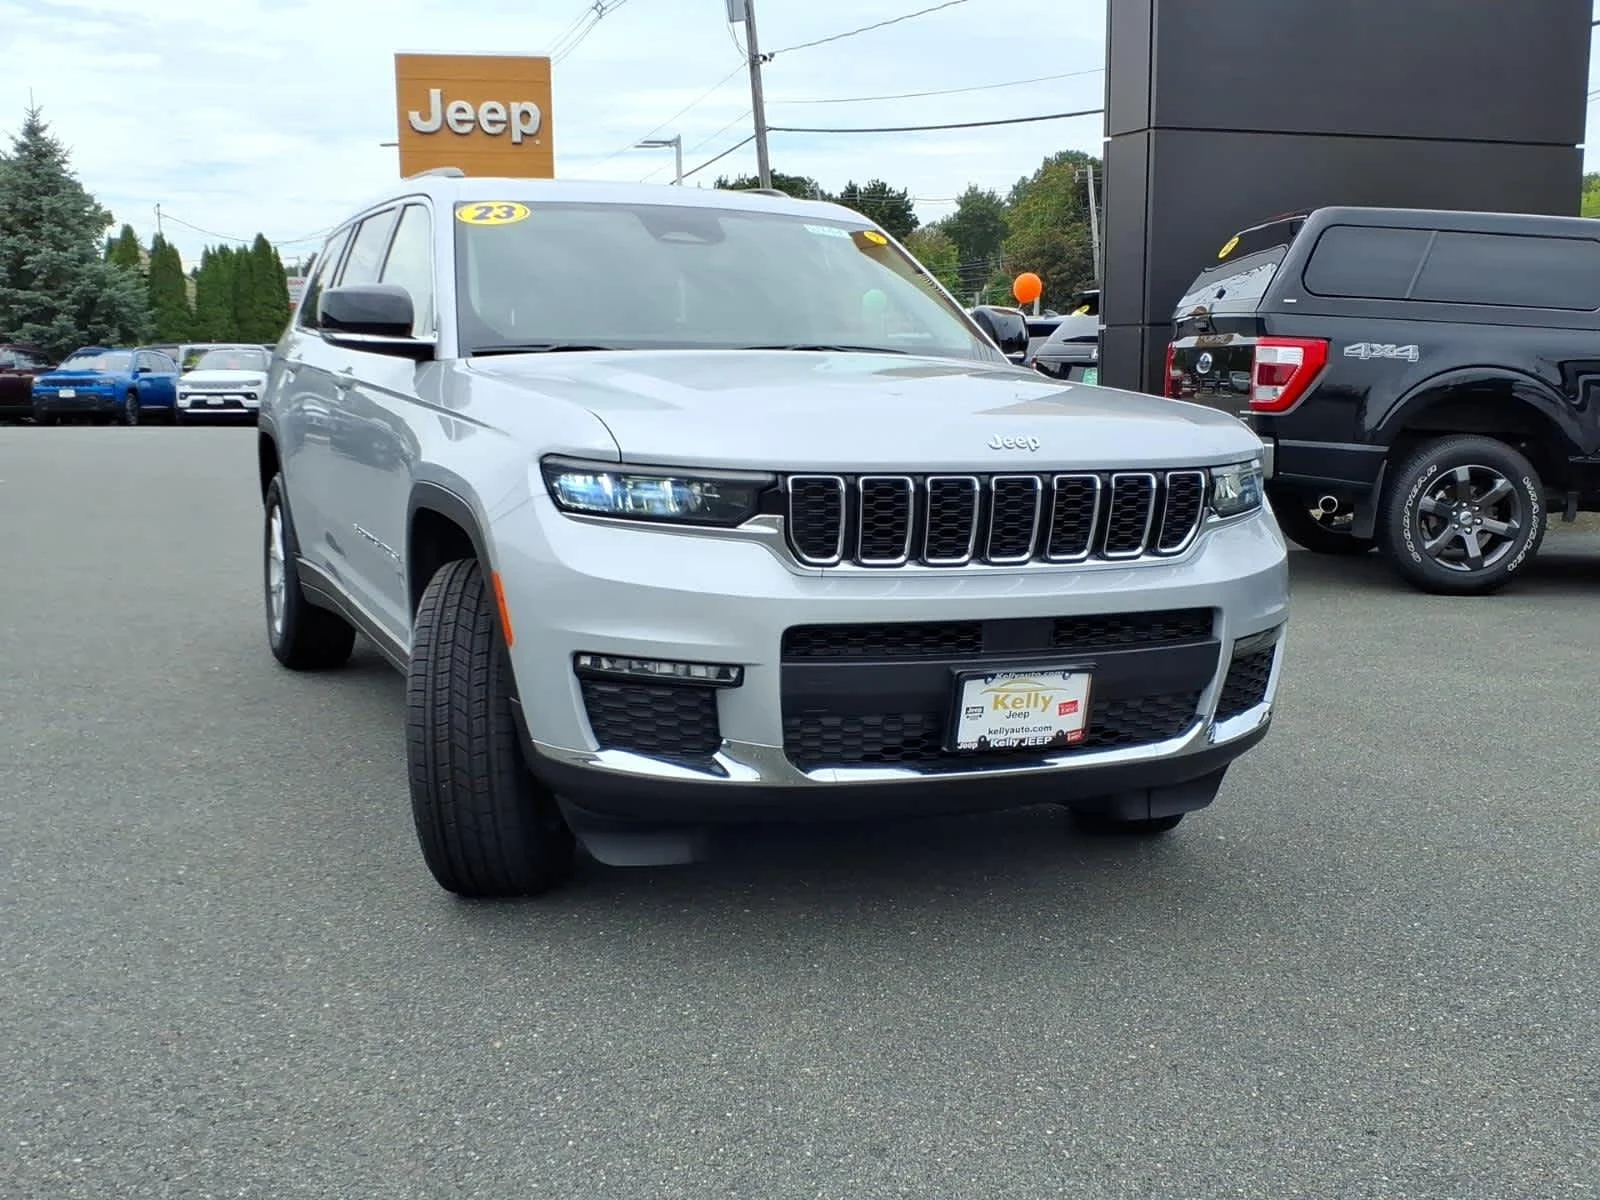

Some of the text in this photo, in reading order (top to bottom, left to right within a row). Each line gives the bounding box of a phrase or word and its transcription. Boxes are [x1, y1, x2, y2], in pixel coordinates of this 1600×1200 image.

[408, 88, 541, 144] Jeep
[471, 205, 516, 220] 23
[986, 432, 1041, 452] Jeep
[992, 691, 1053, 713] Kelly
[1005, 710, 1030, 720] Jeep
[987, 725, 1053, 736] kellyauto.com
[989, 736, 1053, 748] Kelly JEEP
